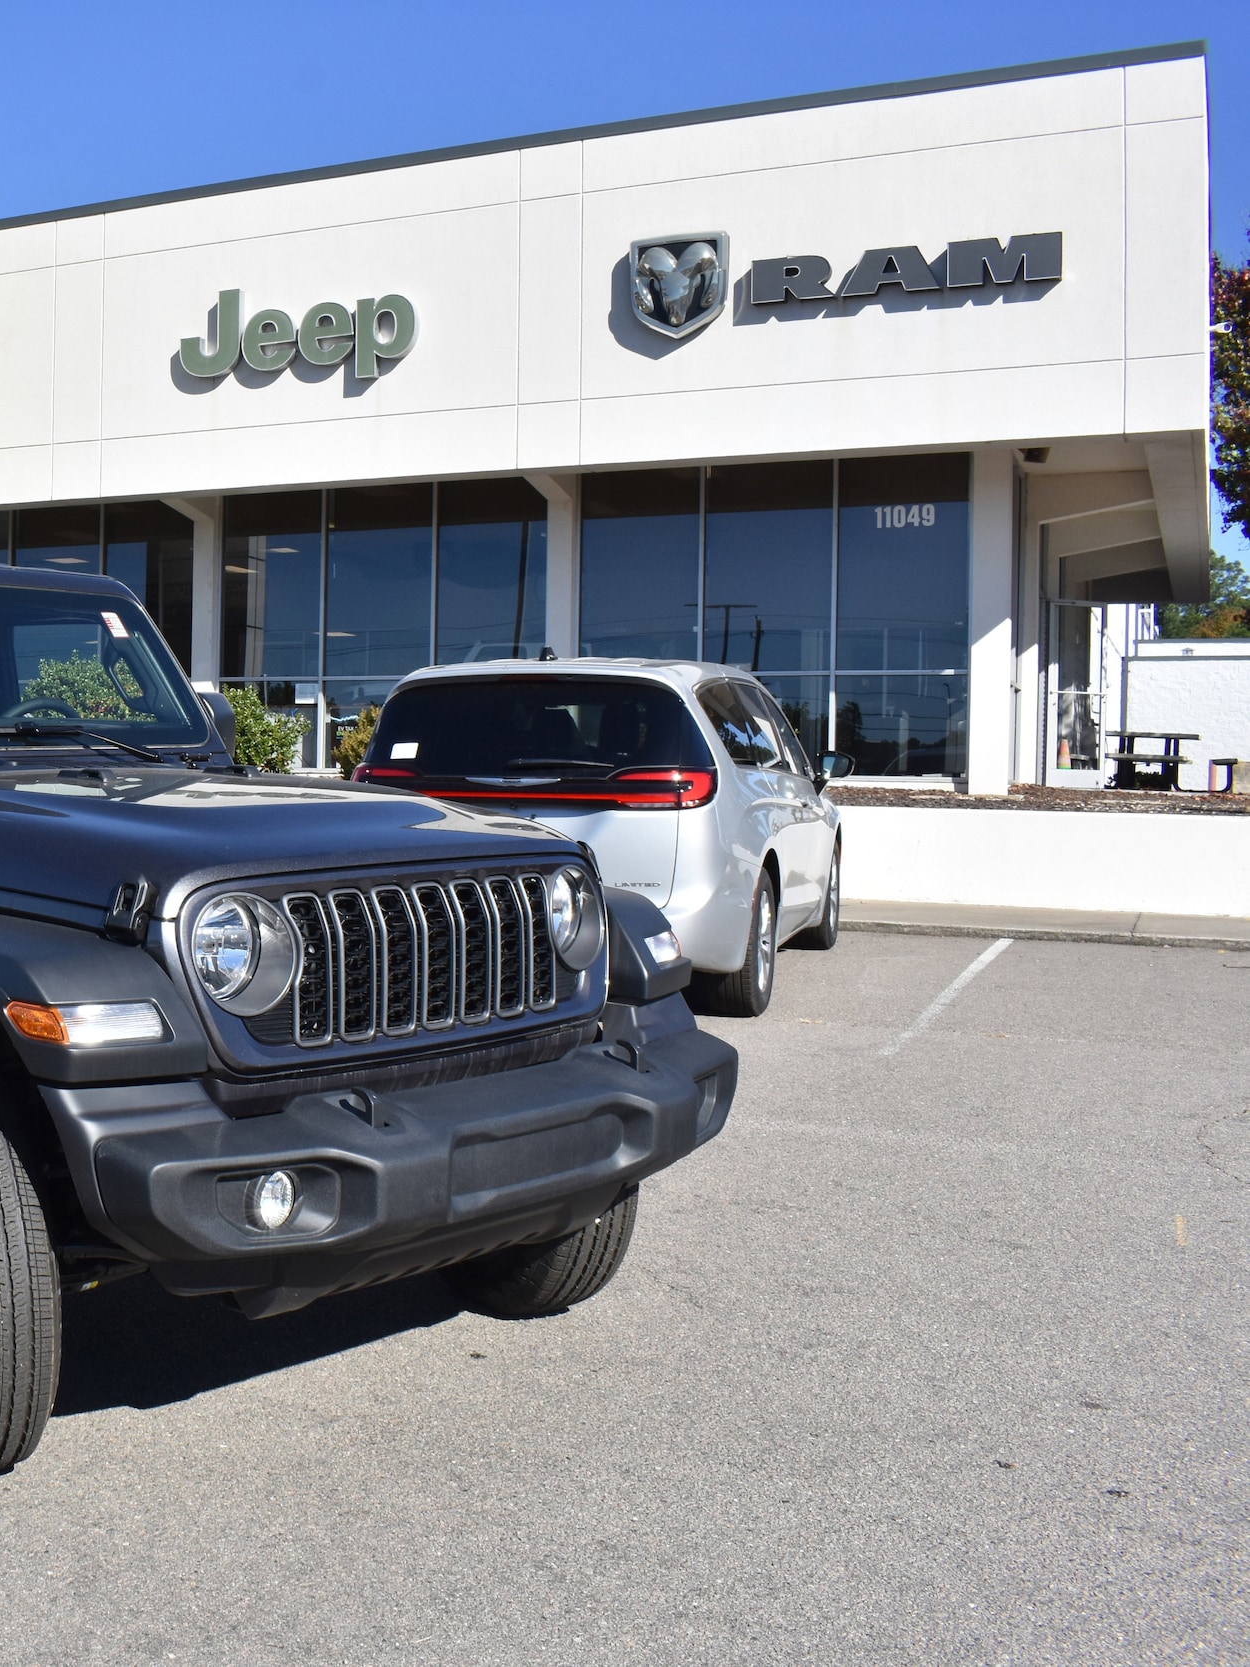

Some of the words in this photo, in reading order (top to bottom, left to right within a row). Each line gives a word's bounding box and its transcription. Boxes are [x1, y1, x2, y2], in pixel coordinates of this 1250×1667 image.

[750, 231, 1064, 305] RAM
[180, 288, 419, 379] Jeep
[874, 503, 936, 529] 11049
